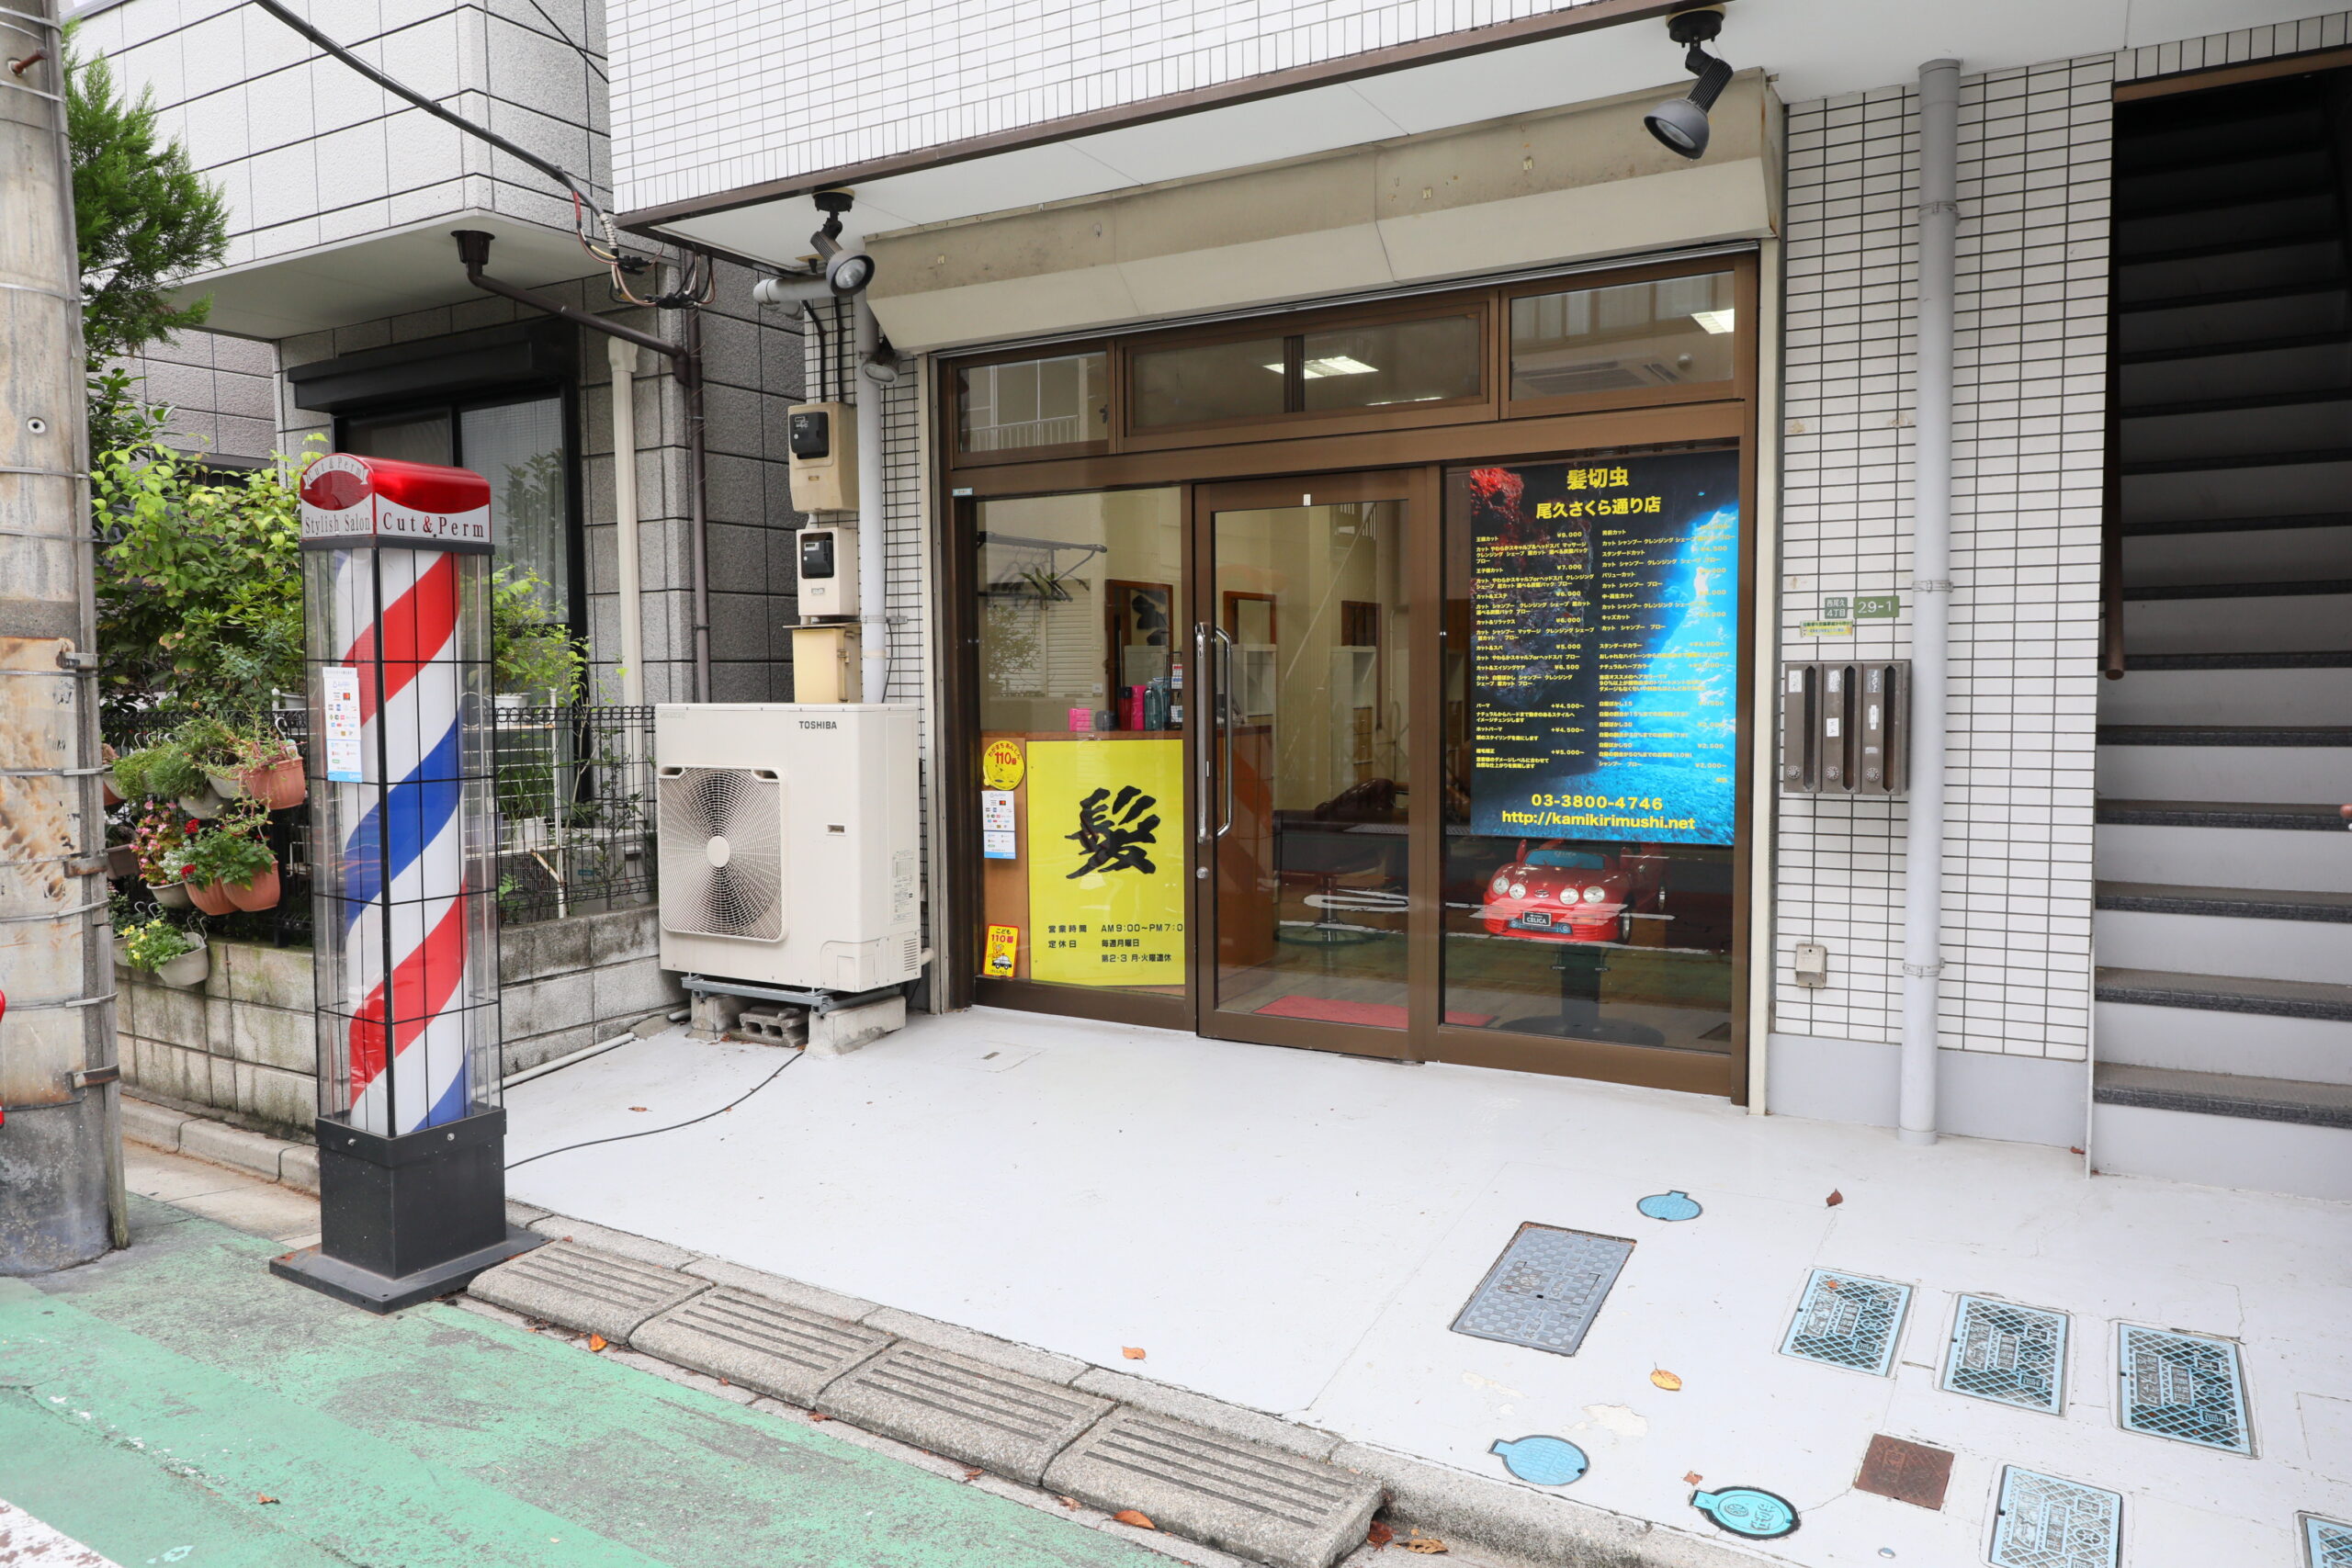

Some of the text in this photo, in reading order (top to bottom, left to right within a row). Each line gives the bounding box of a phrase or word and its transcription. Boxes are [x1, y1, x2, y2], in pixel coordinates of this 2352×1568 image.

[1566, 467, 1629, 491] 髪切虫
[1536, 496, 1662, 520] 尾久さくら通り店
[305, 512, 371, 536] Stylish Salon
[1826, 609, 1846, 617] 4丁目
[1858, 601, 1893, 614] 29-1
[798, 720, 837, 730] TOSHIBA
[1532, 794, 1663, 811] 03-3800-4746
[1501, 810, 1696, 829] http://kamikirimushi.net
[1064, 784, 1162, 880] 髪
[1048, 925, 1087, 933] 営業時間
[1048, 939, 1140, 948] 定休日 毎週月曜日
